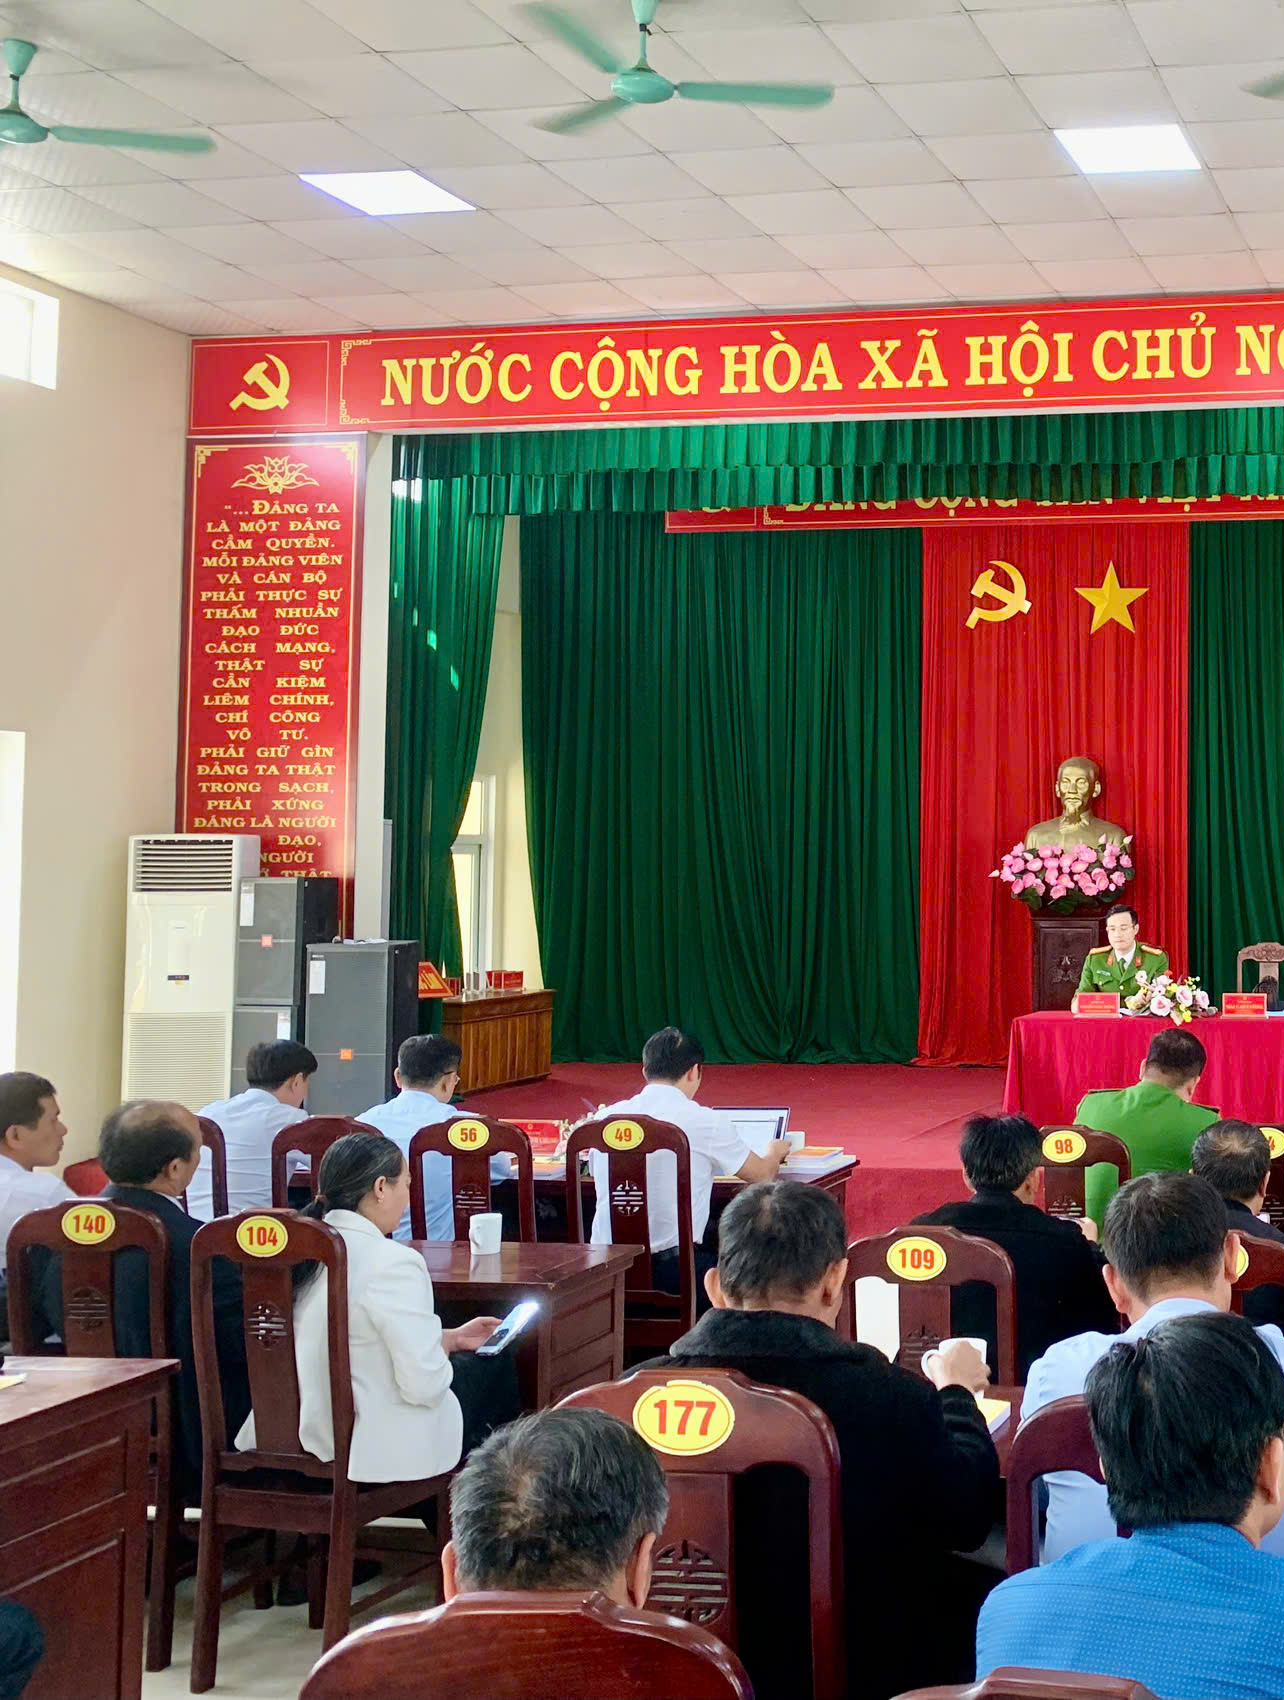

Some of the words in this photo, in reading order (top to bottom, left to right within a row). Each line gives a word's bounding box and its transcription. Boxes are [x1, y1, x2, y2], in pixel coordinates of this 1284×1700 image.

[381, 349, 532, 406] NƯỚC
[546, 336, 705, 415] CỘNG
[720, 330, 843, 394] HÒA
[858, 328, 948, 389] XÃ
[963, 320, 1072, 400] HỘI
[1092, 312, 1216, 381] CHỦ
[315, 503, 340, 513] TA
[207, 520, 230, 532] LÀ
[240, 519, 280, 534] MỘT
[289, 517, 341, 531] ĐẢNG
[212, 534, 253, 550] CẦM
[242, 553, 294, 566] ĐẢNG
[298, 552, 343, 565] VIÊN
[216, 571, 242, 584] VÀ
[253, 571, 291, 584] CÁN
[303, 570, 327, 585] BỘ
[201, 588, 245, 601] PHẢI
[256, 589, 307, 603] THỰC
[318, 588, 343, 602] SỰ
[222, 625, 260, 638] ĐẠO
[280, 622, 319, 635] ĐỨC
[205, 640, 256, 653] CÁCH
[214, 658, 265, 672] THẬT
[299, 658, 324, 672] SỰ
[276, 675, 326, 689] KIỆM
[204, 693, 249, 705] LIÊM
[215, 710, 248, 723] CHÍ
[269, 710, 320, 722] CÔNG
[226, 727, 251, 740] VÔ
[200, 744, 245, 757] PHẢI
[301, 744, 334, 757] GÌN
[197, 761, 249, 775] ĐẢNG
[255, 765, 280, 775] TA
[285, 762, 336, 777] THẬT
[198, 782, 261, 792] TRONG
[207, 796, 251, 810] PHẢI
[250, 815, 274, 827] LÀ
[279, 815, 337, 830] NGƯỜI
[459, 1127, 477, 1143] 56
[614, 1127, 633, 1143] 49
[1054, 1139, 1074, 1154] 98
[71, 1213, 106, 1235] 140
[245, 1225, 278, 1247] 104
[898, 1247, 936, 1270] 109
[654, 1400, 716, 1436] 177
